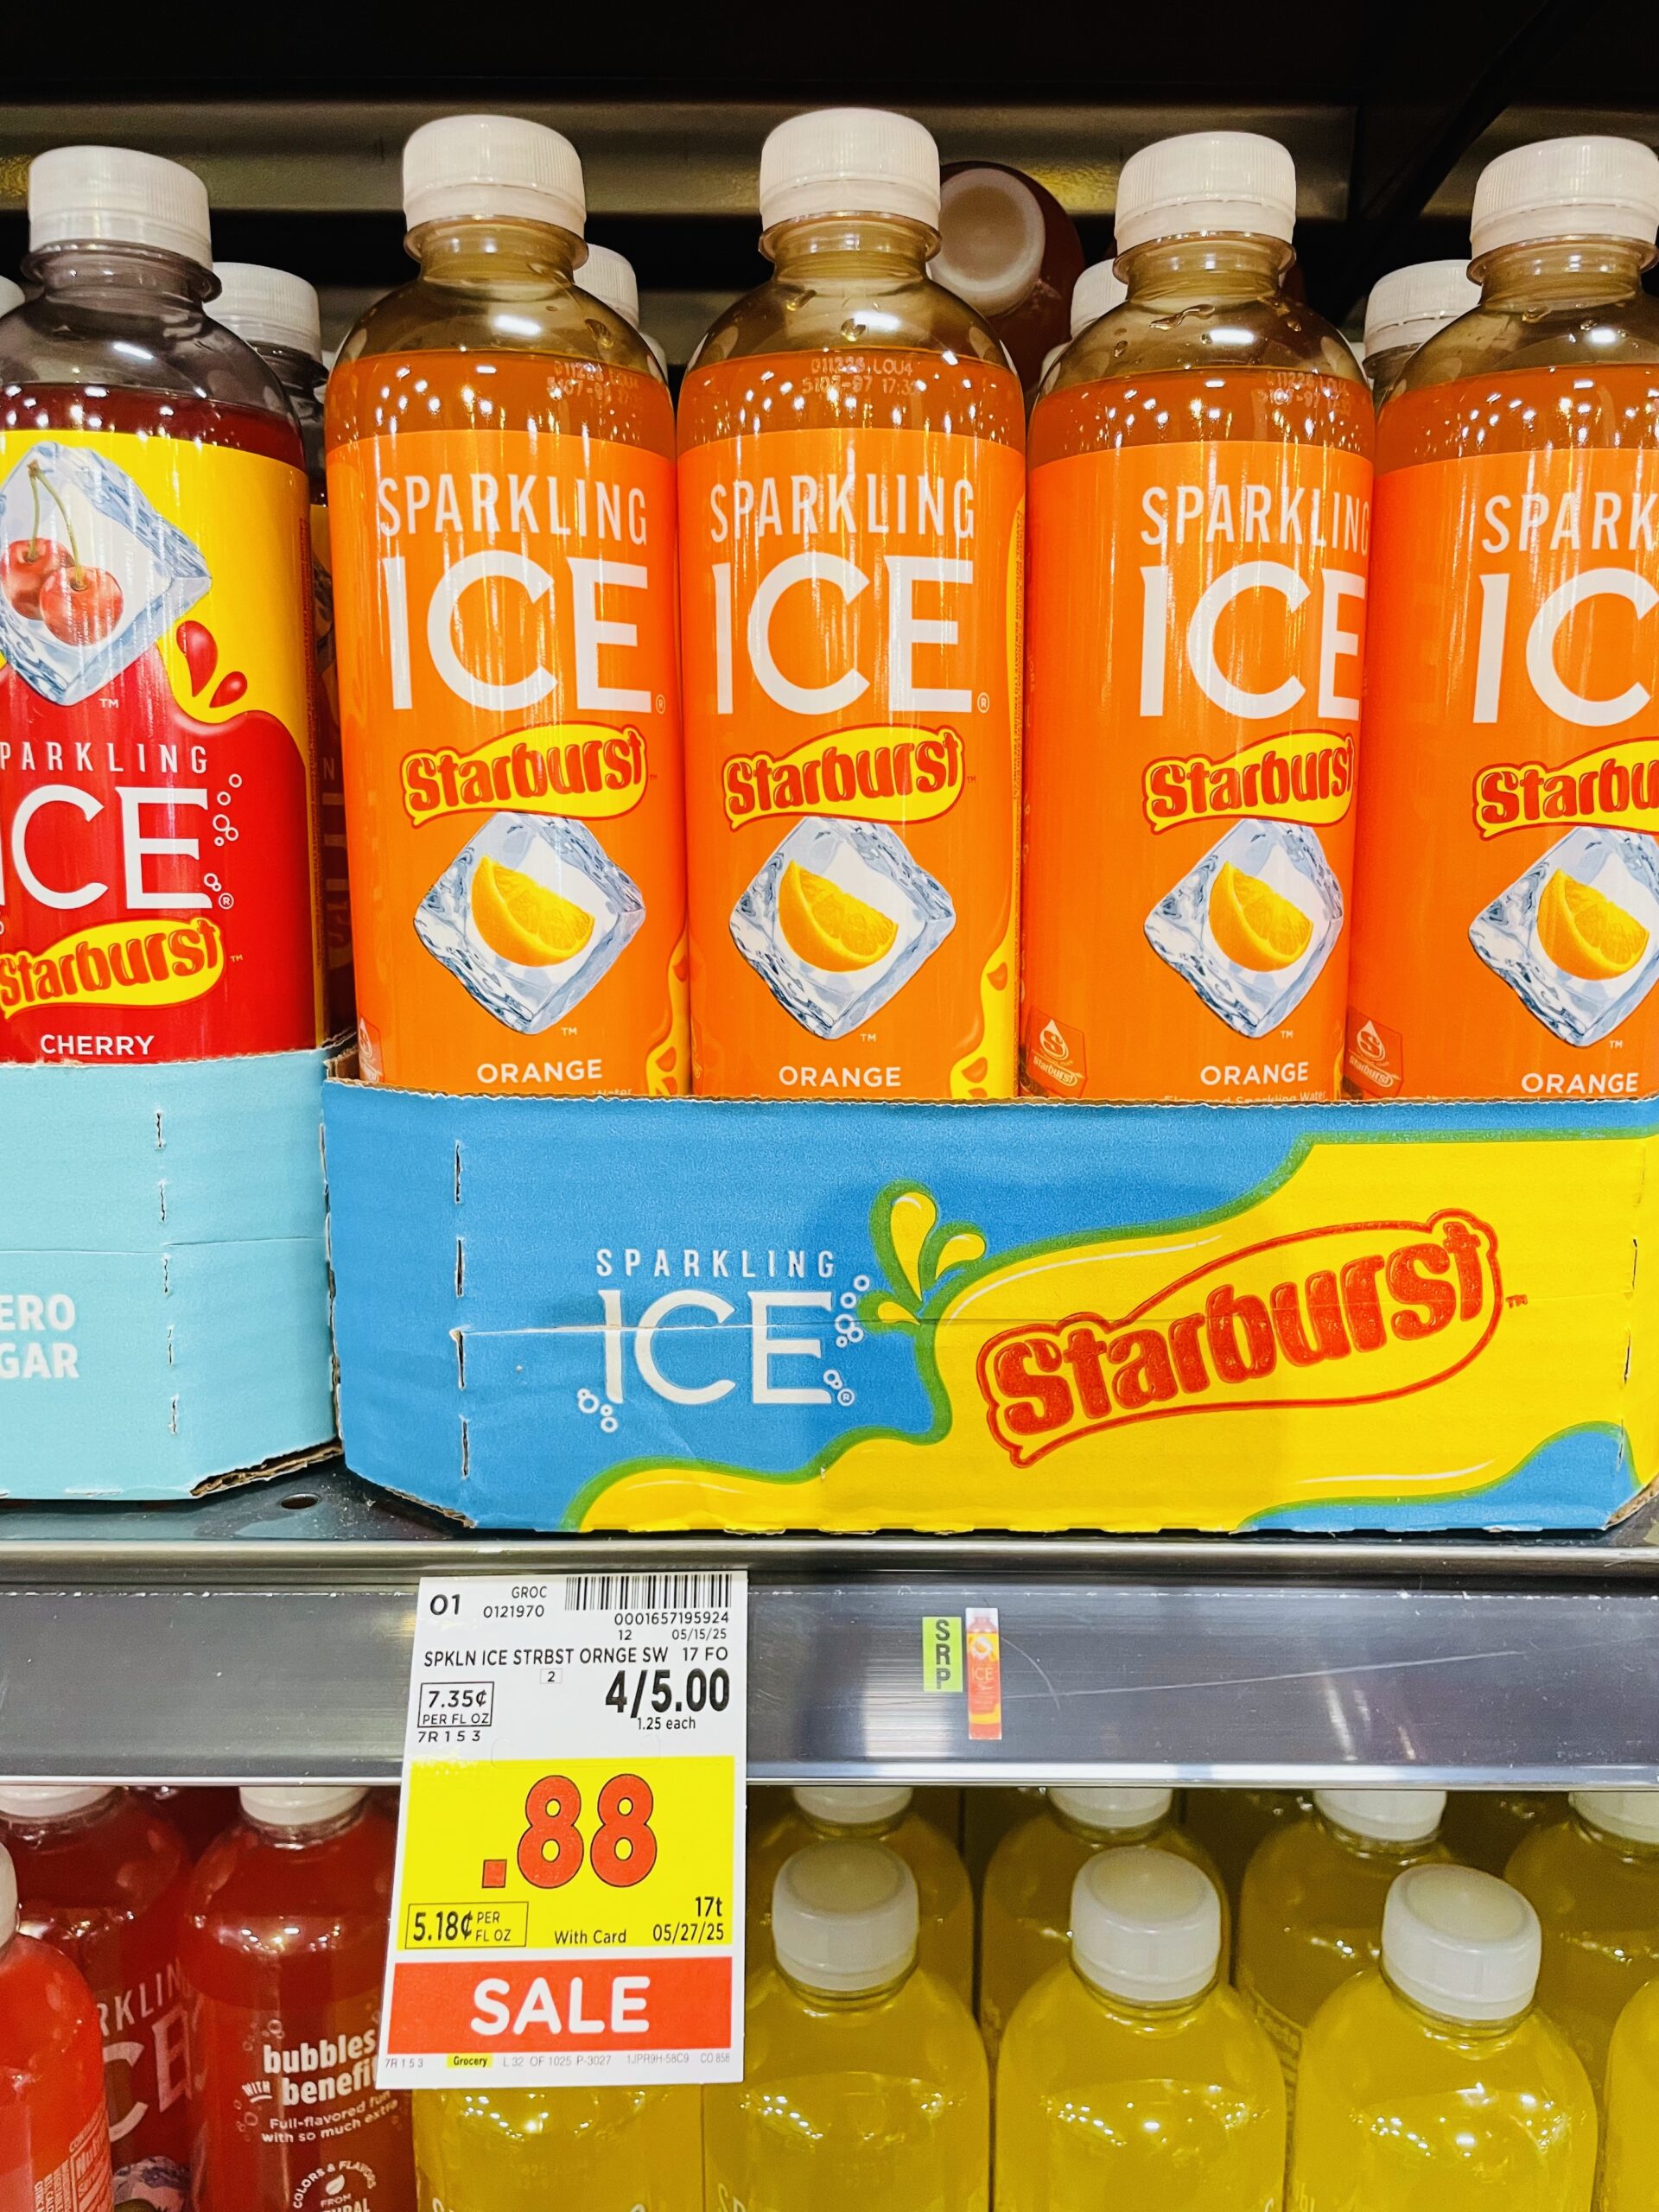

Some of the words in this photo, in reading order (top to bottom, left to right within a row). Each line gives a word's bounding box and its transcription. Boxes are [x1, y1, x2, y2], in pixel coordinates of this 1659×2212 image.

[378, 474, 647, 546] SPARKLING
[710, 474, 974, 543] SPARKLING
[1141, 485, 1369, 556] SPARKLING
[1482, 492, 1659, 554] SPARK
[383, 550, 652, 713] ICE
[712, 552, 973, 715] ICE
[1140, 561, 1366, 719] ICE
[1473, 568, 1659, 726] IC
[405, 731, 642, 810] Starburst
[728, 733, 958, 815] Starburst
[1482, 759, 1659, 823] Starbu
[0, 918, 219, 1007] Starburst
[41, 1034, 155, 1055] CHERRY
[477, 1059, 602, 1084] ORANGE
[779, 1066, 901, 1087] ORANGE
[1200, 1062, 1309, 1086] ORANGE
[1522, 1072, 1638, 1094] ORANGE
[596, 1249, 835, 1278] SPARKLING
[0, 1294, 75, 1331] ERO
[995, 1222, 1485, 1435] Starburst
[599, 1289, 832, 1404] ICE
[0, 1343, 79, 1378] GAR
[512, 1586, 547, 1599] GROC
[483, 1605, 544, 1618] 0121970
[614, 1611, 729, 1625] 0001657195924
[618, 1630, 632, 1641] 12
[671, 1628, 727, 1641] 05/15/25
[424, 1650, 476, 1667] SPKLN
[482, 1649, 507, 1666] ICE
[513, 1649, 574, 1665] STRBST
[579, 1648, 637, 1664] ORNGE
[642, 1646, 668, 1662] SW
[683, 1647, 696, 1661] 17
[706, 1646, 728, 1661] FO
[547, 1671, 556, 1682] 2
[973, 1667, 994, 1680] ICE
[429, 1689, 487, 1708] 7.35¢
[605, 1668, 730, 1719] 4/5.00
[423, 1714, 448, 1725] PER
[452, 1713, 467, 1724] FL
[471, 1713, 489, 1724] OZ
[638, 1717, 661, 1730] 1.25
[665, 1717, 696, 1729] each
[481, 1773, 658, 1889] .88
[477, 1911, 499, 1923] PER
[695, 1896, 722, 1917] 17t
[413, 1910, 473, 1941] 5.18¢
[476, 1929, 489, 1942] FL
[494, 1929, 511, 1942] OZ
[555, 1929, 588, 1945] With
[594, 1929, 626, 1944] Card
[652, 1923, 724, 1943] 05/27/25
[470, 1976, 651, 2036] SALE
[263, 2029, 376, 2074] bubbles
[454, 2056, 487, 2068] Grocery
[512, 2057, 524, 2067] 32
[530, 2057, 544, 2067] OF
[549, 2056, 571, 2066] 1025
[576, 2055, 612, 2066] P-3027
[700, 2053, 714, 2063] CO
[242, 2081, 270, 2096] WITH
[262, 2132, 294, 2143] with
[298, 2132, 316, 2142] so
[320, 2119, 361, 2139] much
[365, 2100, 397, 2123] extra
[270, 2101, 365, 2130] Full-flavored
[293, 2168, 326, 2209] COLORS
